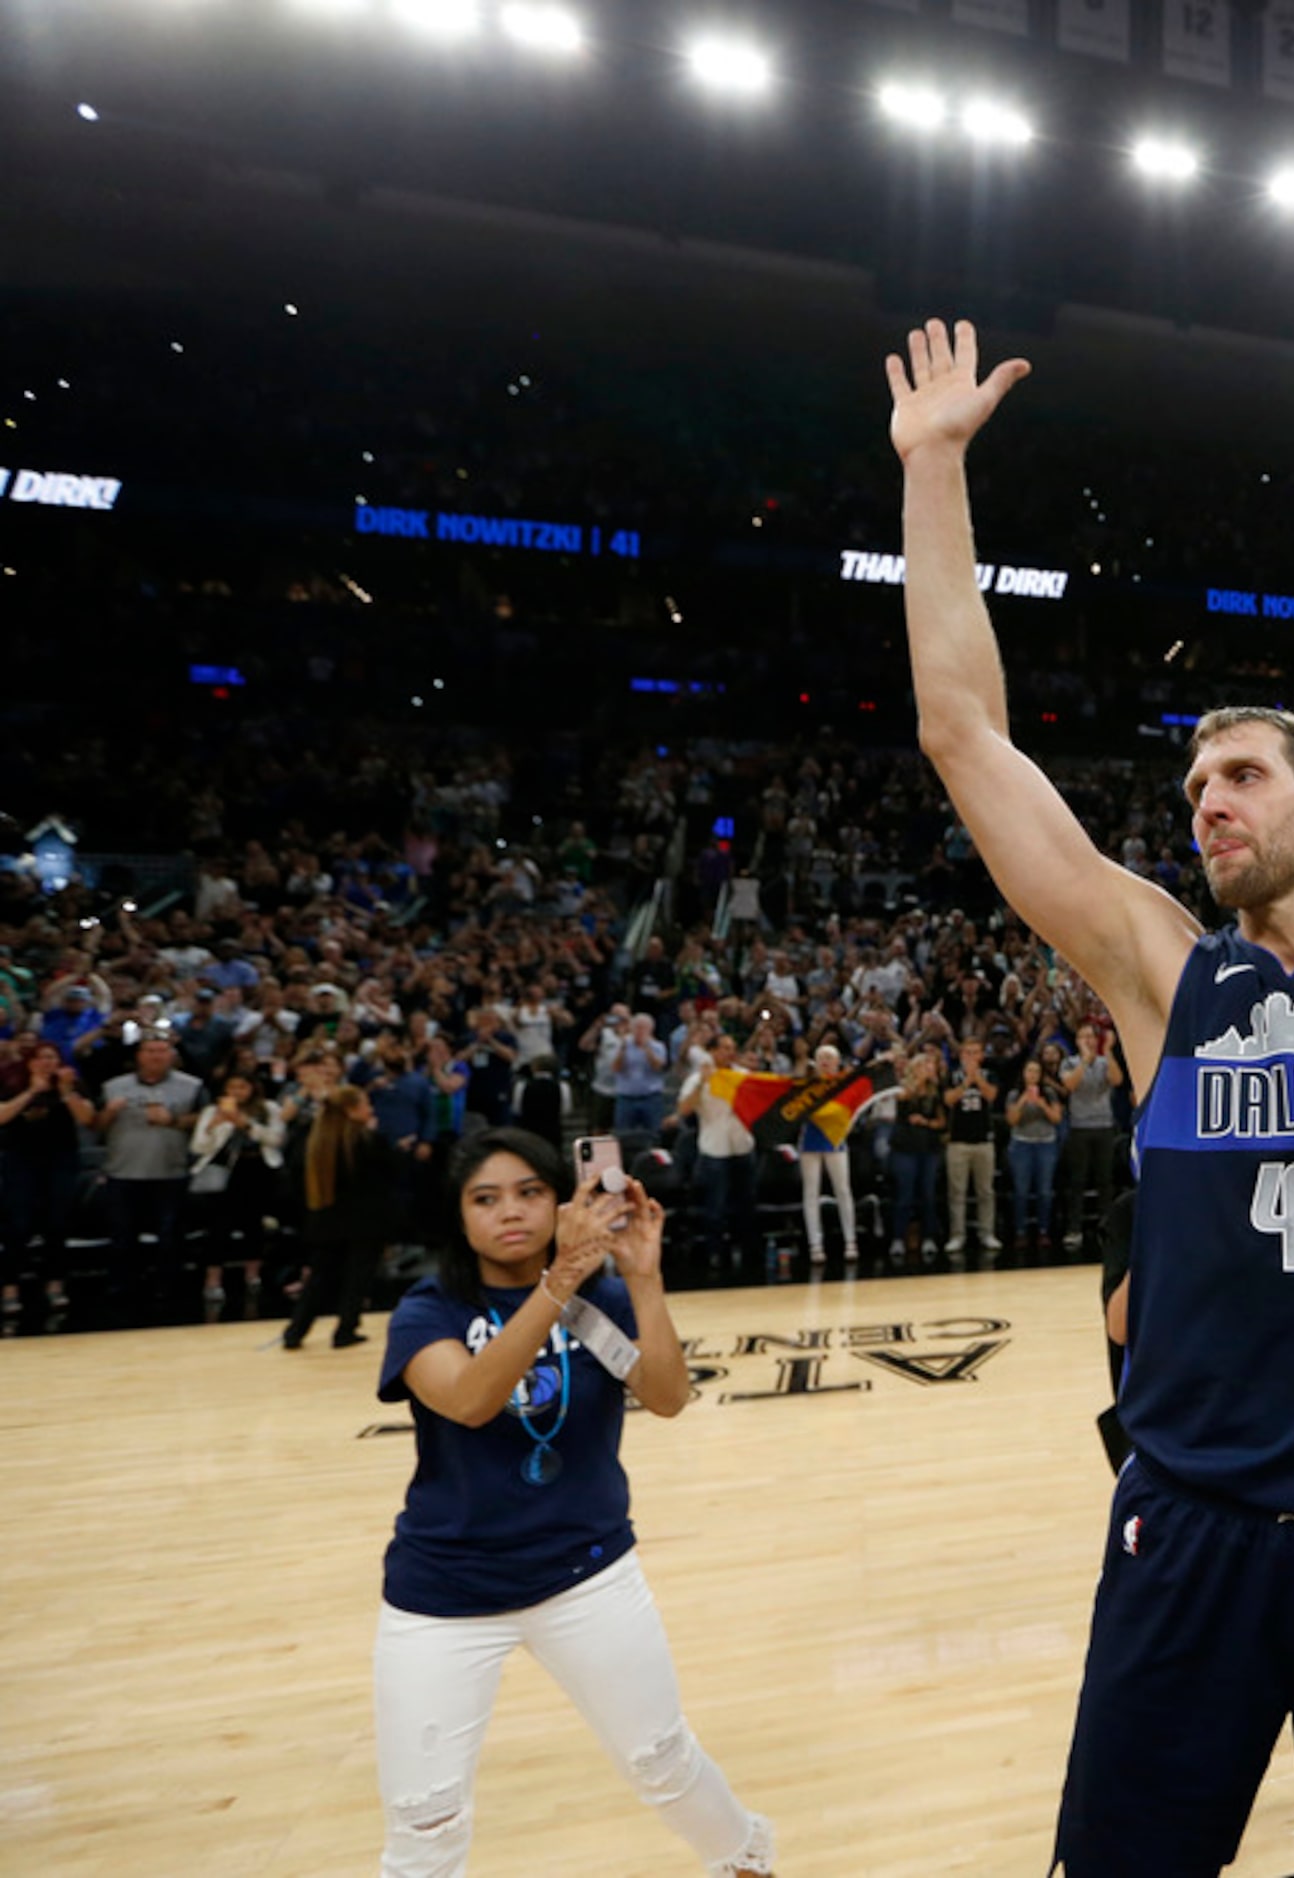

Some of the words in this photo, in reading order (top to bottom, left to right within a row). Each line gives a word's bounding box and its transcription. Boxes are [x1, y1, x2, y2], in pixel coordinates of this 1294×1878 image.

[9, 469, 122, 509] DIRK!
[355, 505, 430, 538] DIRK
[436, 512, 582, 553] NOWITZKI
[609, 528, 640, 558] 41
[839, 549, 906, 585] THAN
[994, 564, 1068, 599] DIRK!
[1206, 588, 1258, 617] DIRK
